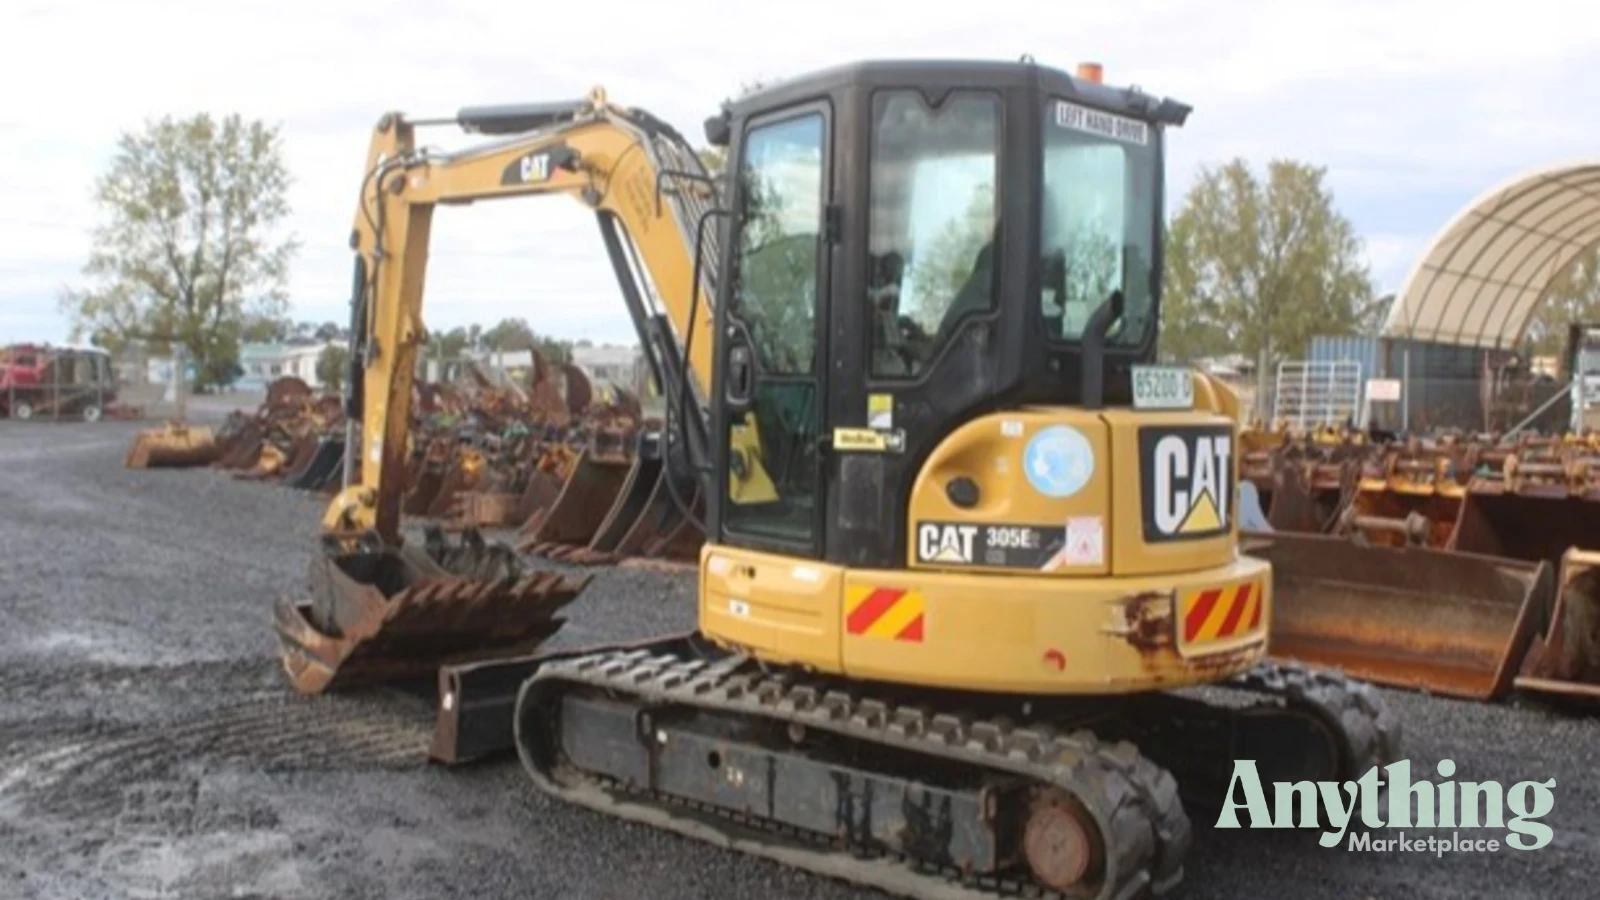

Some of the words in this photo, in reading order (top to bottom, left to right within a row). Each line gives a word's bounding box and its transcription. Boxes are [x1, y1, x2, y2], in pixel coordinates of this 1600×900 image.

[1058, 103, 1083, 127] LEFT
[1115, 116, 1145, 143] DRIVE
[520, 153, 549, 182] CAT
[1154, 435, 1231, 534] CAT
[919, 523, 978, 562] CAT
